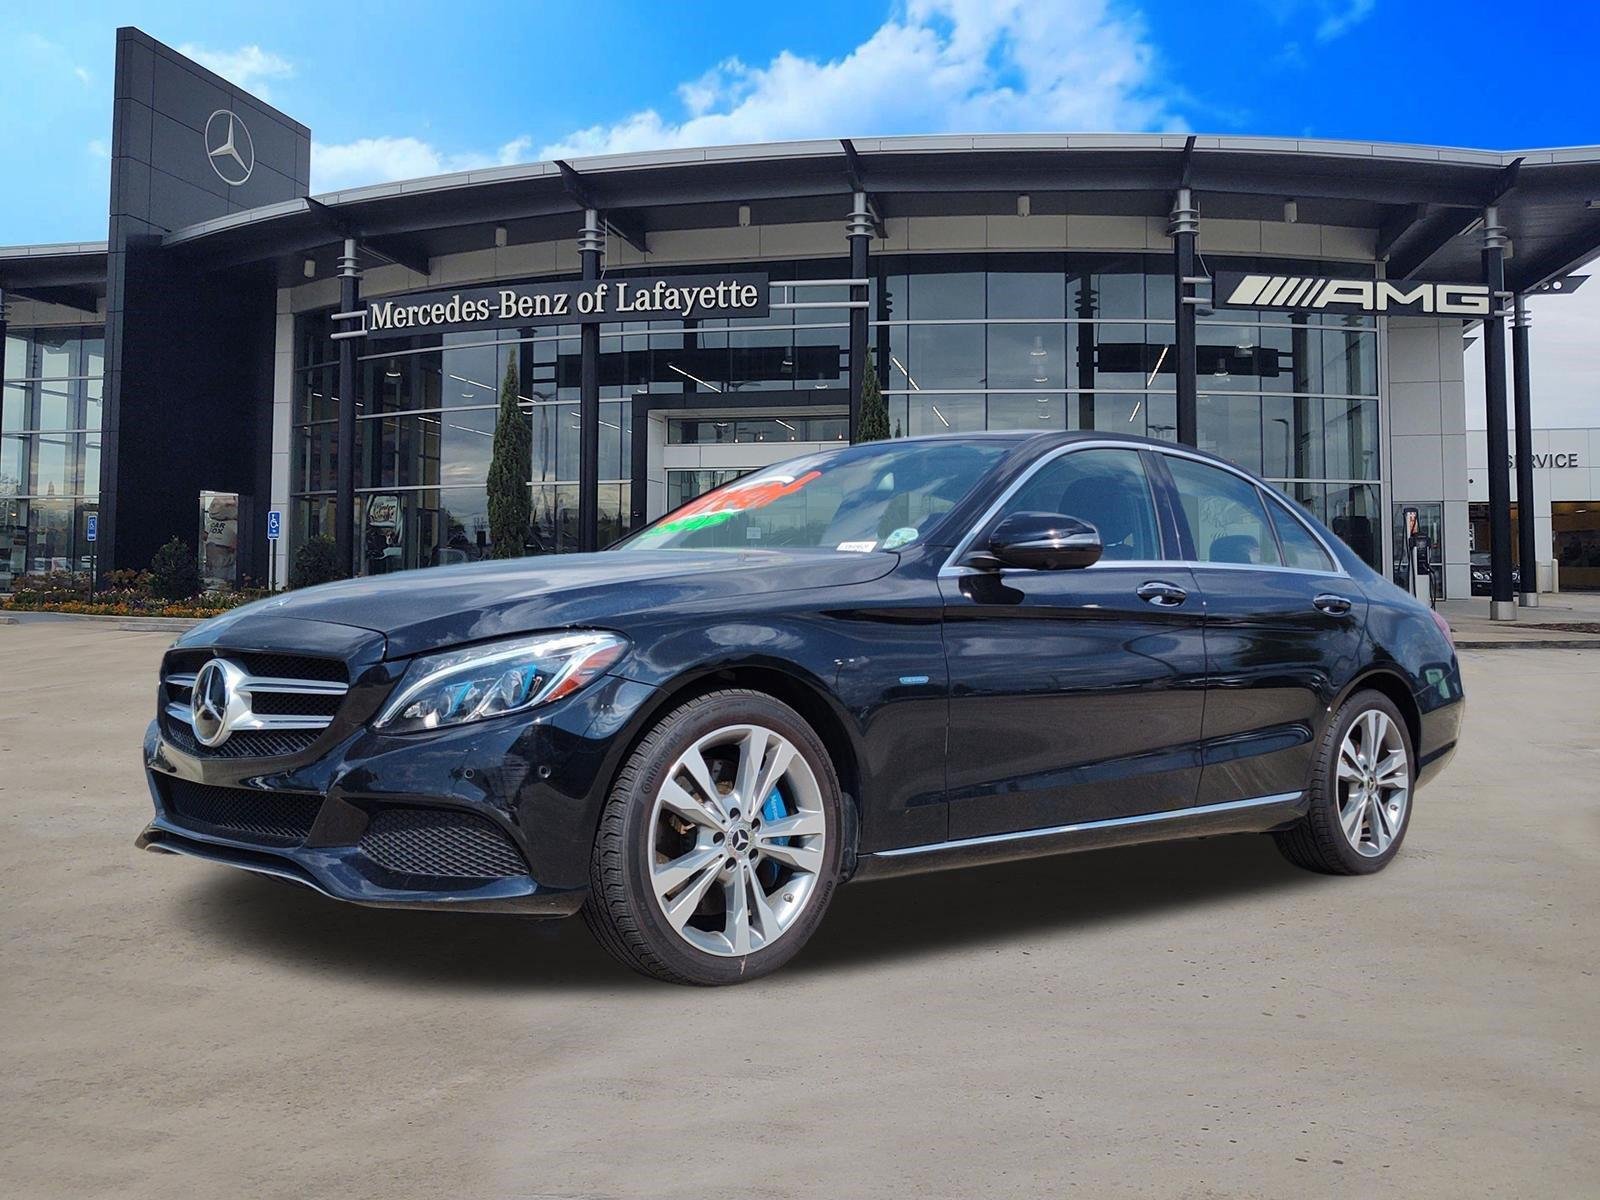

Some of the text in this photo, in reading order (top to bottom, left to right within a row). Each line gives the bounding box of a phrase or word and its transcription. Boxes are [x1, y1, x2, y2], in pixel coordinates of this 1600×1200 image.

[370, 281, 759, 331] Mercedes-Benz of Lafayette
[1312, 279, 1490, 315] AMG
[1507, 453, 1578, 468] SRVICE
